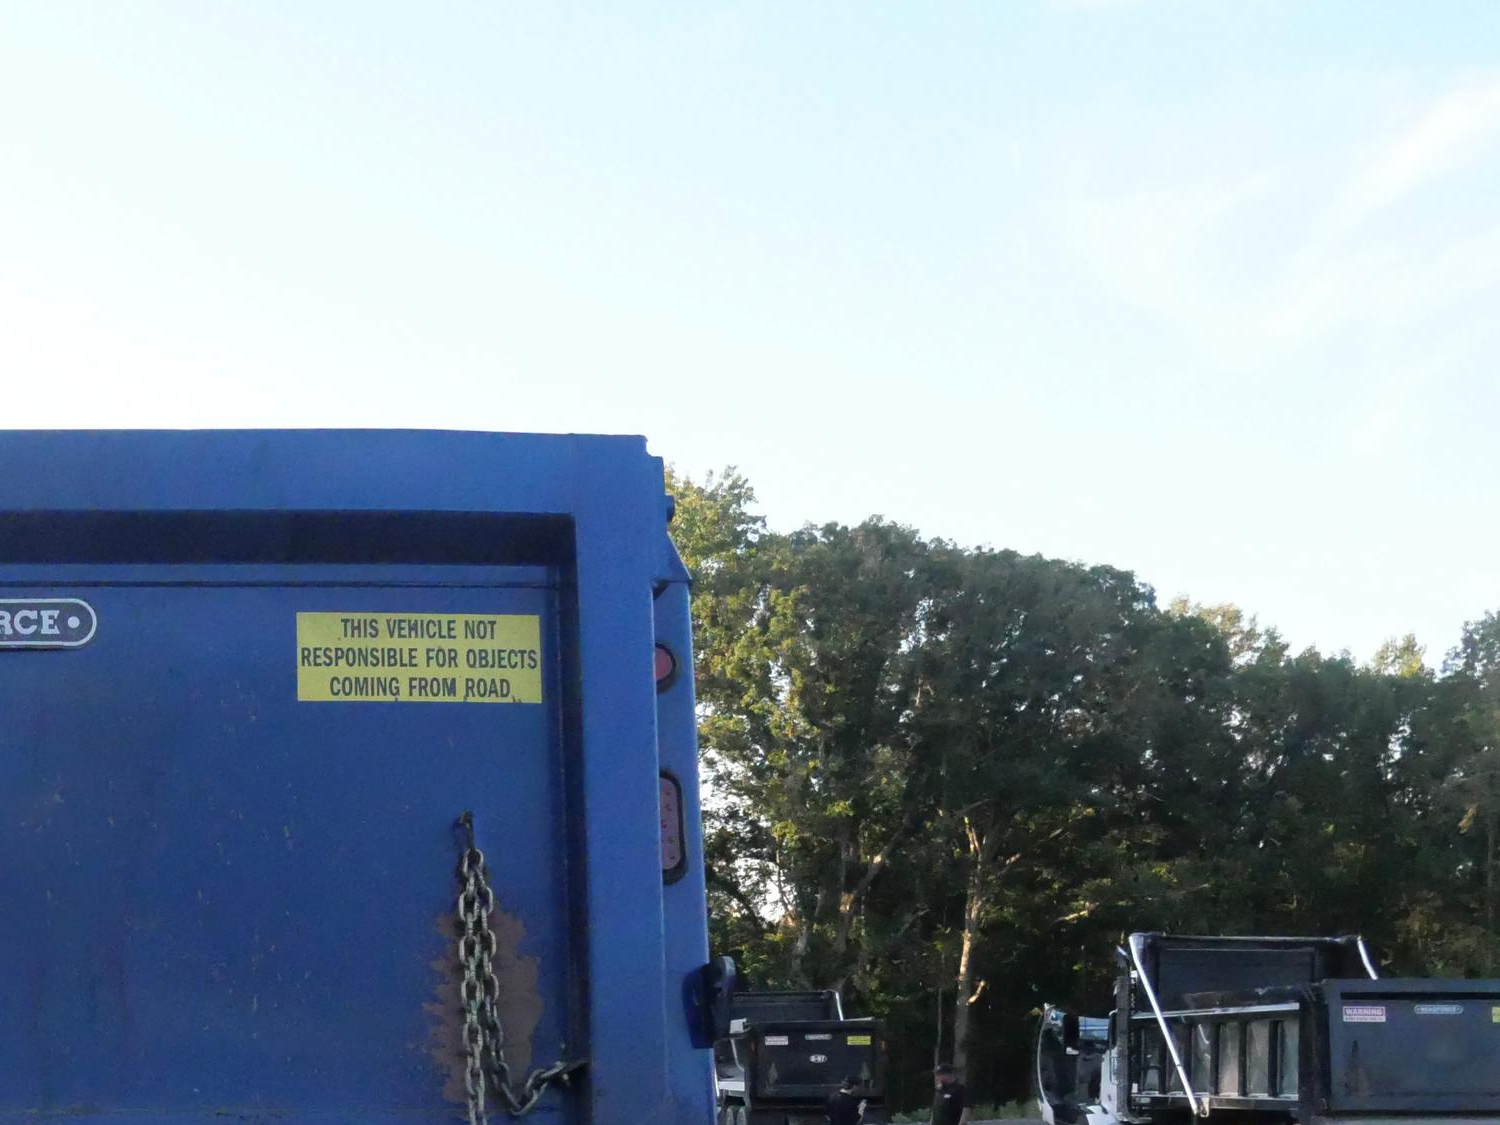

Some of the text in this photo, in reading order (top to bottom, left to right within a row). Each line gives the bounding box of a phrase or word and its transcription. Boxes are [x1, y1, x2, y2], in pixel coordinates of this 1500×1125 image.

[341, 618, 497, 640] THIS VEHICLE NOT
[301, 647, 538, 669] RESPONSIBLE FOR OBJECTS
[330, 676, 511, 698] COMING FROM ROAD
